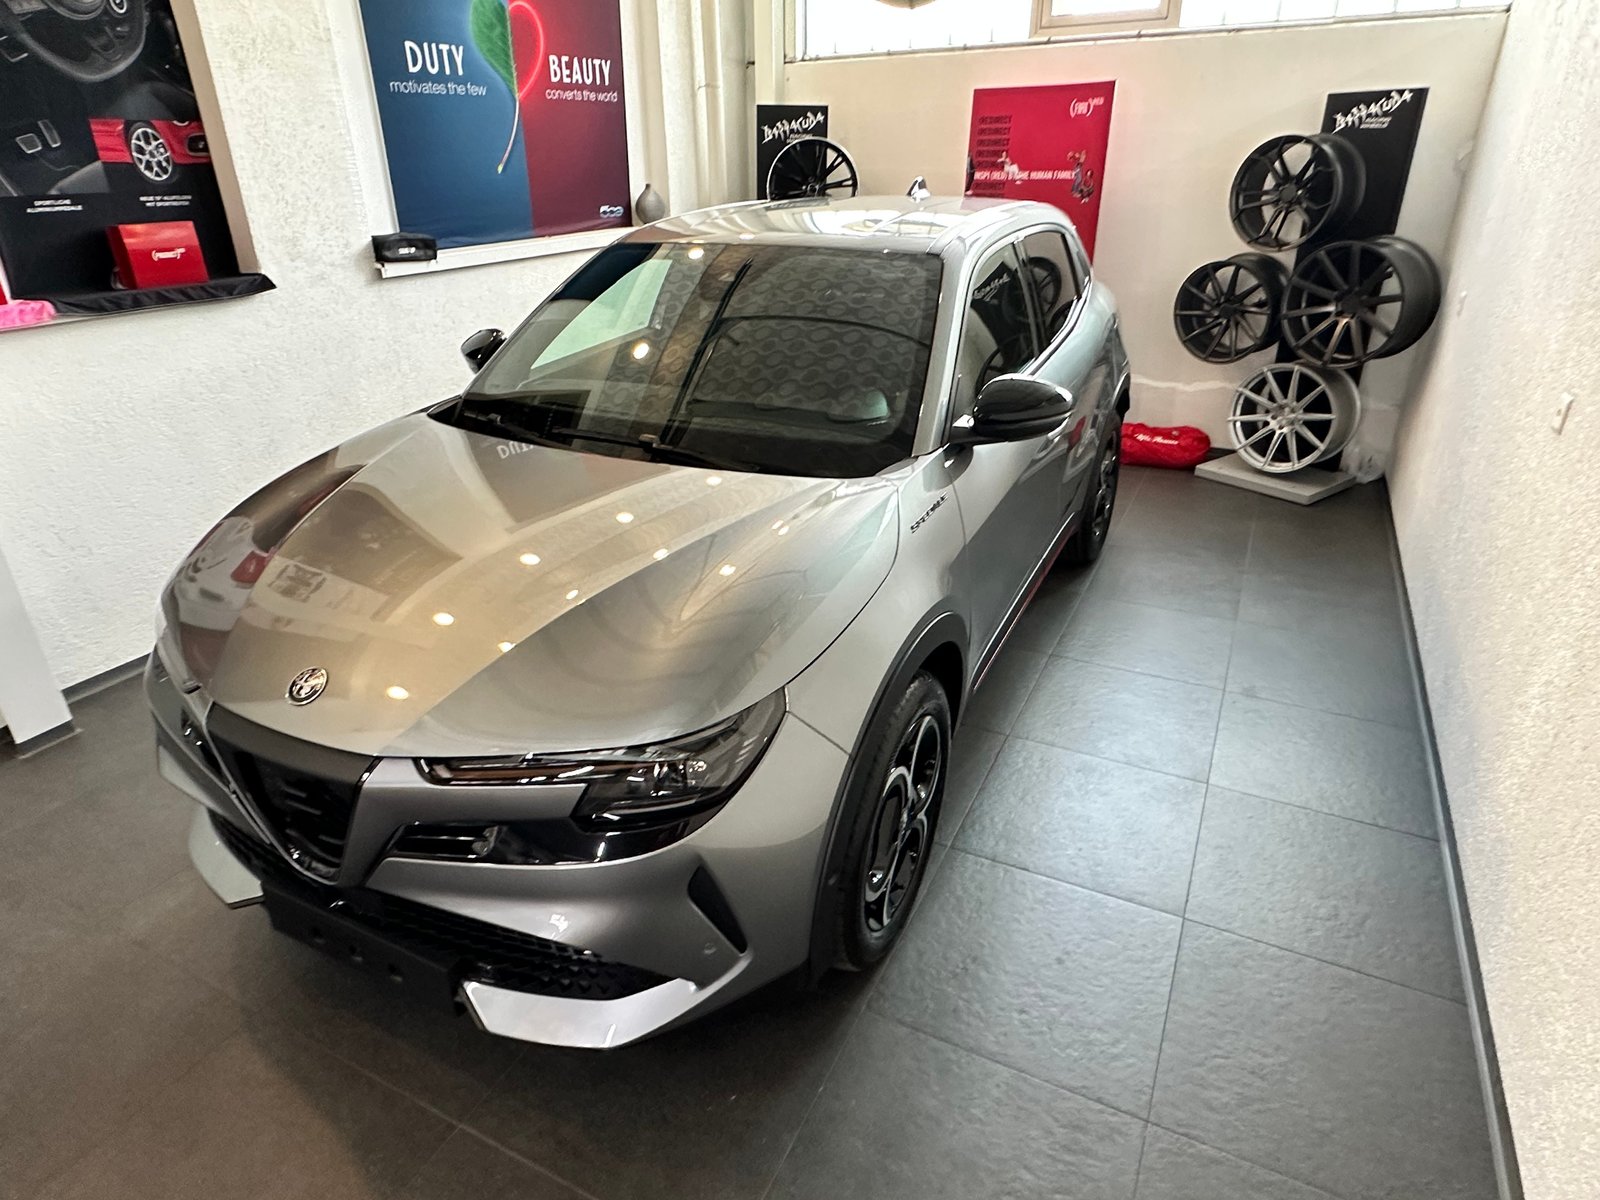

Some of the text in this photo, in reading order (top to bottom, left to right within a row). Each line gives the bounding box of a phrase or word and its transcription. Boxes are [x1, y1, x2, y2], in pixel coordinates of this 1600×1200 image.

[404, 40, 464, 76] DUTY
[549, 55, 611, 86] BEAUTY
[389, 80, 487, 96] motivates the few
[545, 88, 618, 102] converts the world
